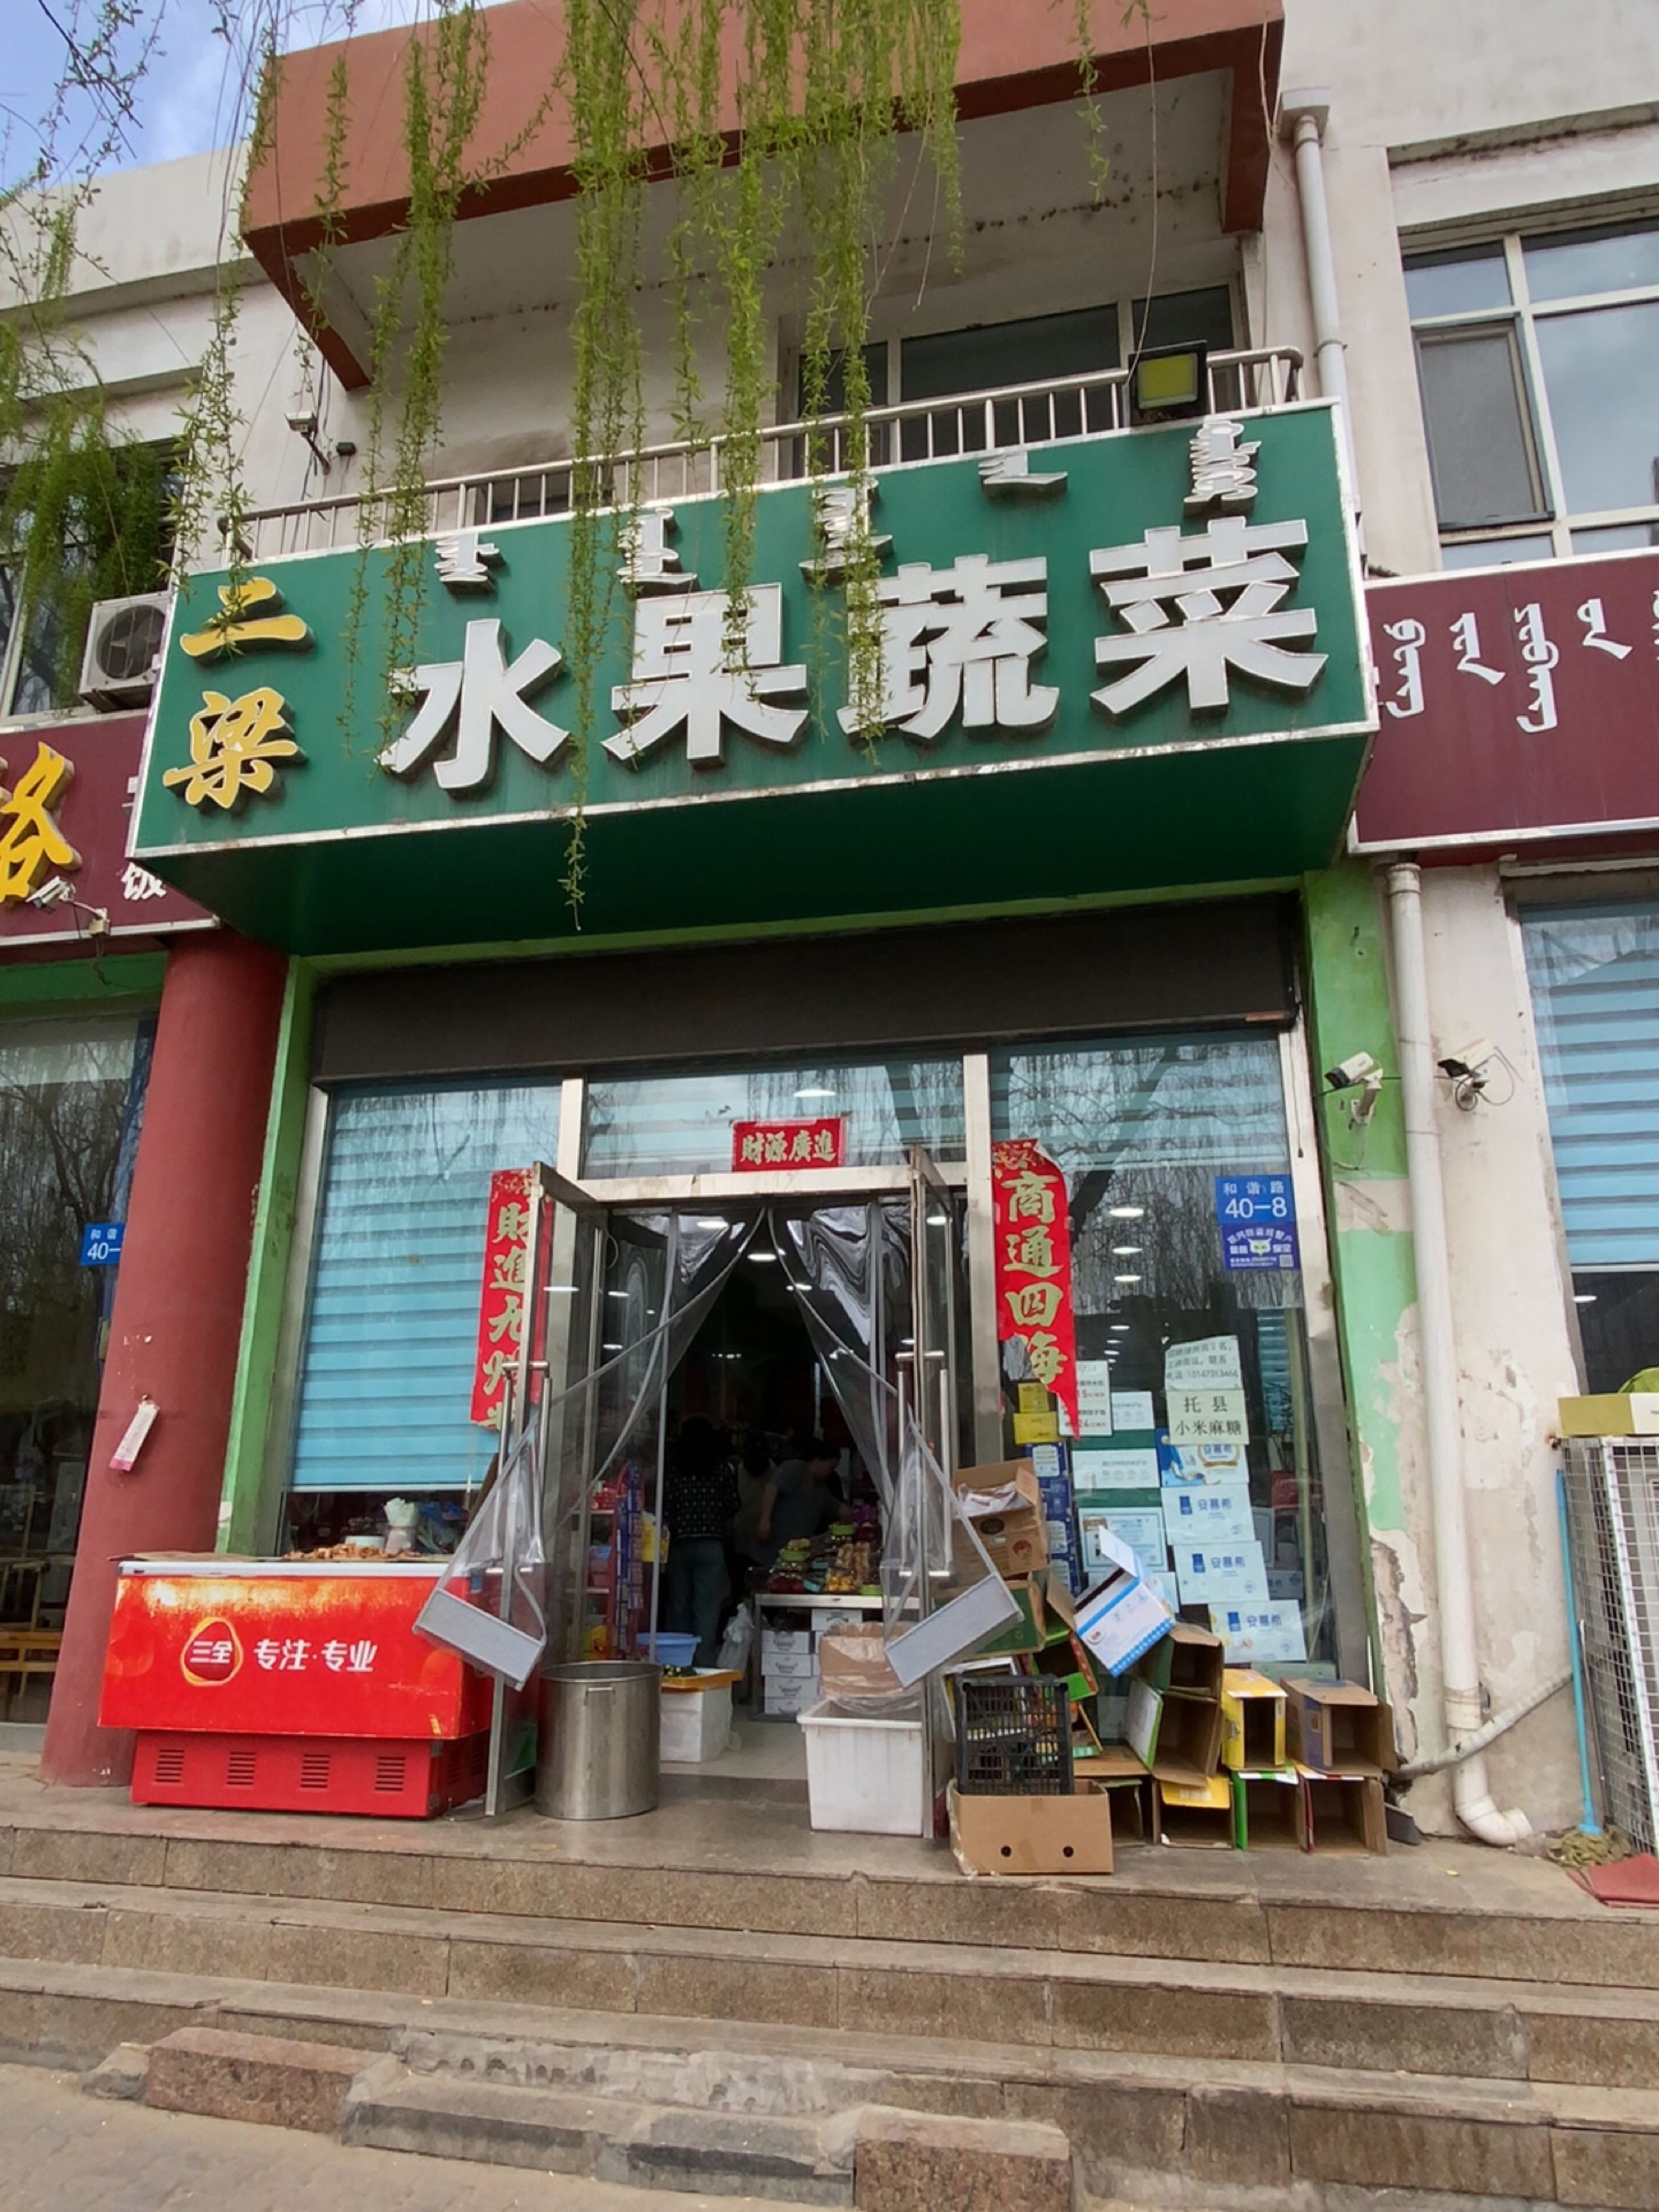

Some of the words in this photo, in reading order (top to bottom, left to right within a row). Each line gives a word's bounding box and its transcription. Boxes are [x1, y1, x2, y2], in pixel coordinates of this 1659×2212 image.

[376, 516, 1329, 790] 水果蔬菜
[164, 577, 310, 809] 二梁
[1222, 1180, 1284, 1195] 和谐路
[1174, 1420, 1242, 1436] 小米麻糖
[189, 1640, 234, 1664] 三全
